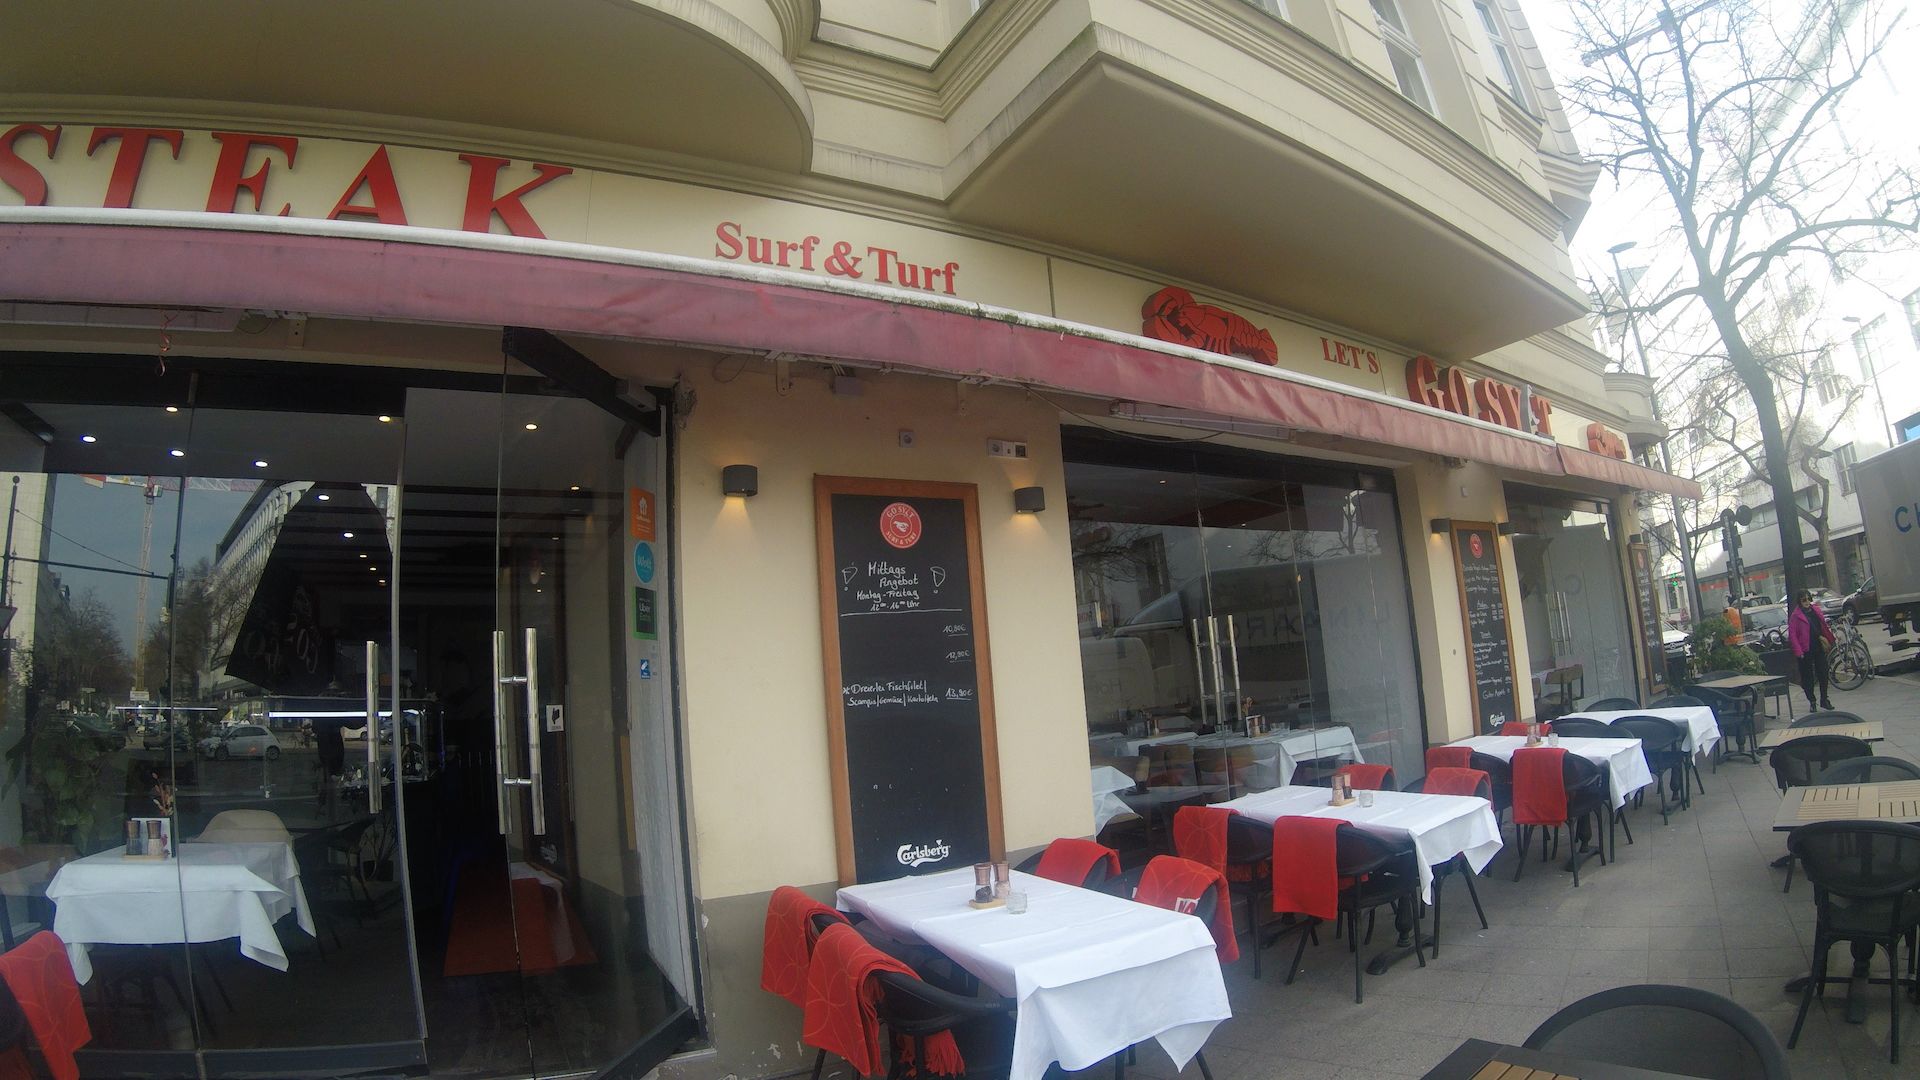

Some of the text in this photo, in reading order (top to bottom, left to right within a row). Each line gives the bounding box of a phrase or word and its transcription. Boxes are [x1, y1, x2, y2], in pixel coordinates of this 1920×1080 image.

[0, 122, 573, 239] STEAK
[715, 221, 960, 296] Surf & Turf
[1320, 336, 1379, 374] LET'S
[1405, 354, 1474, 417] GO
[879, 573, 919, 591] Angebot
[906, 600, 920, 608] Uhr
[897, 839, 951, 868] Carlsberg
